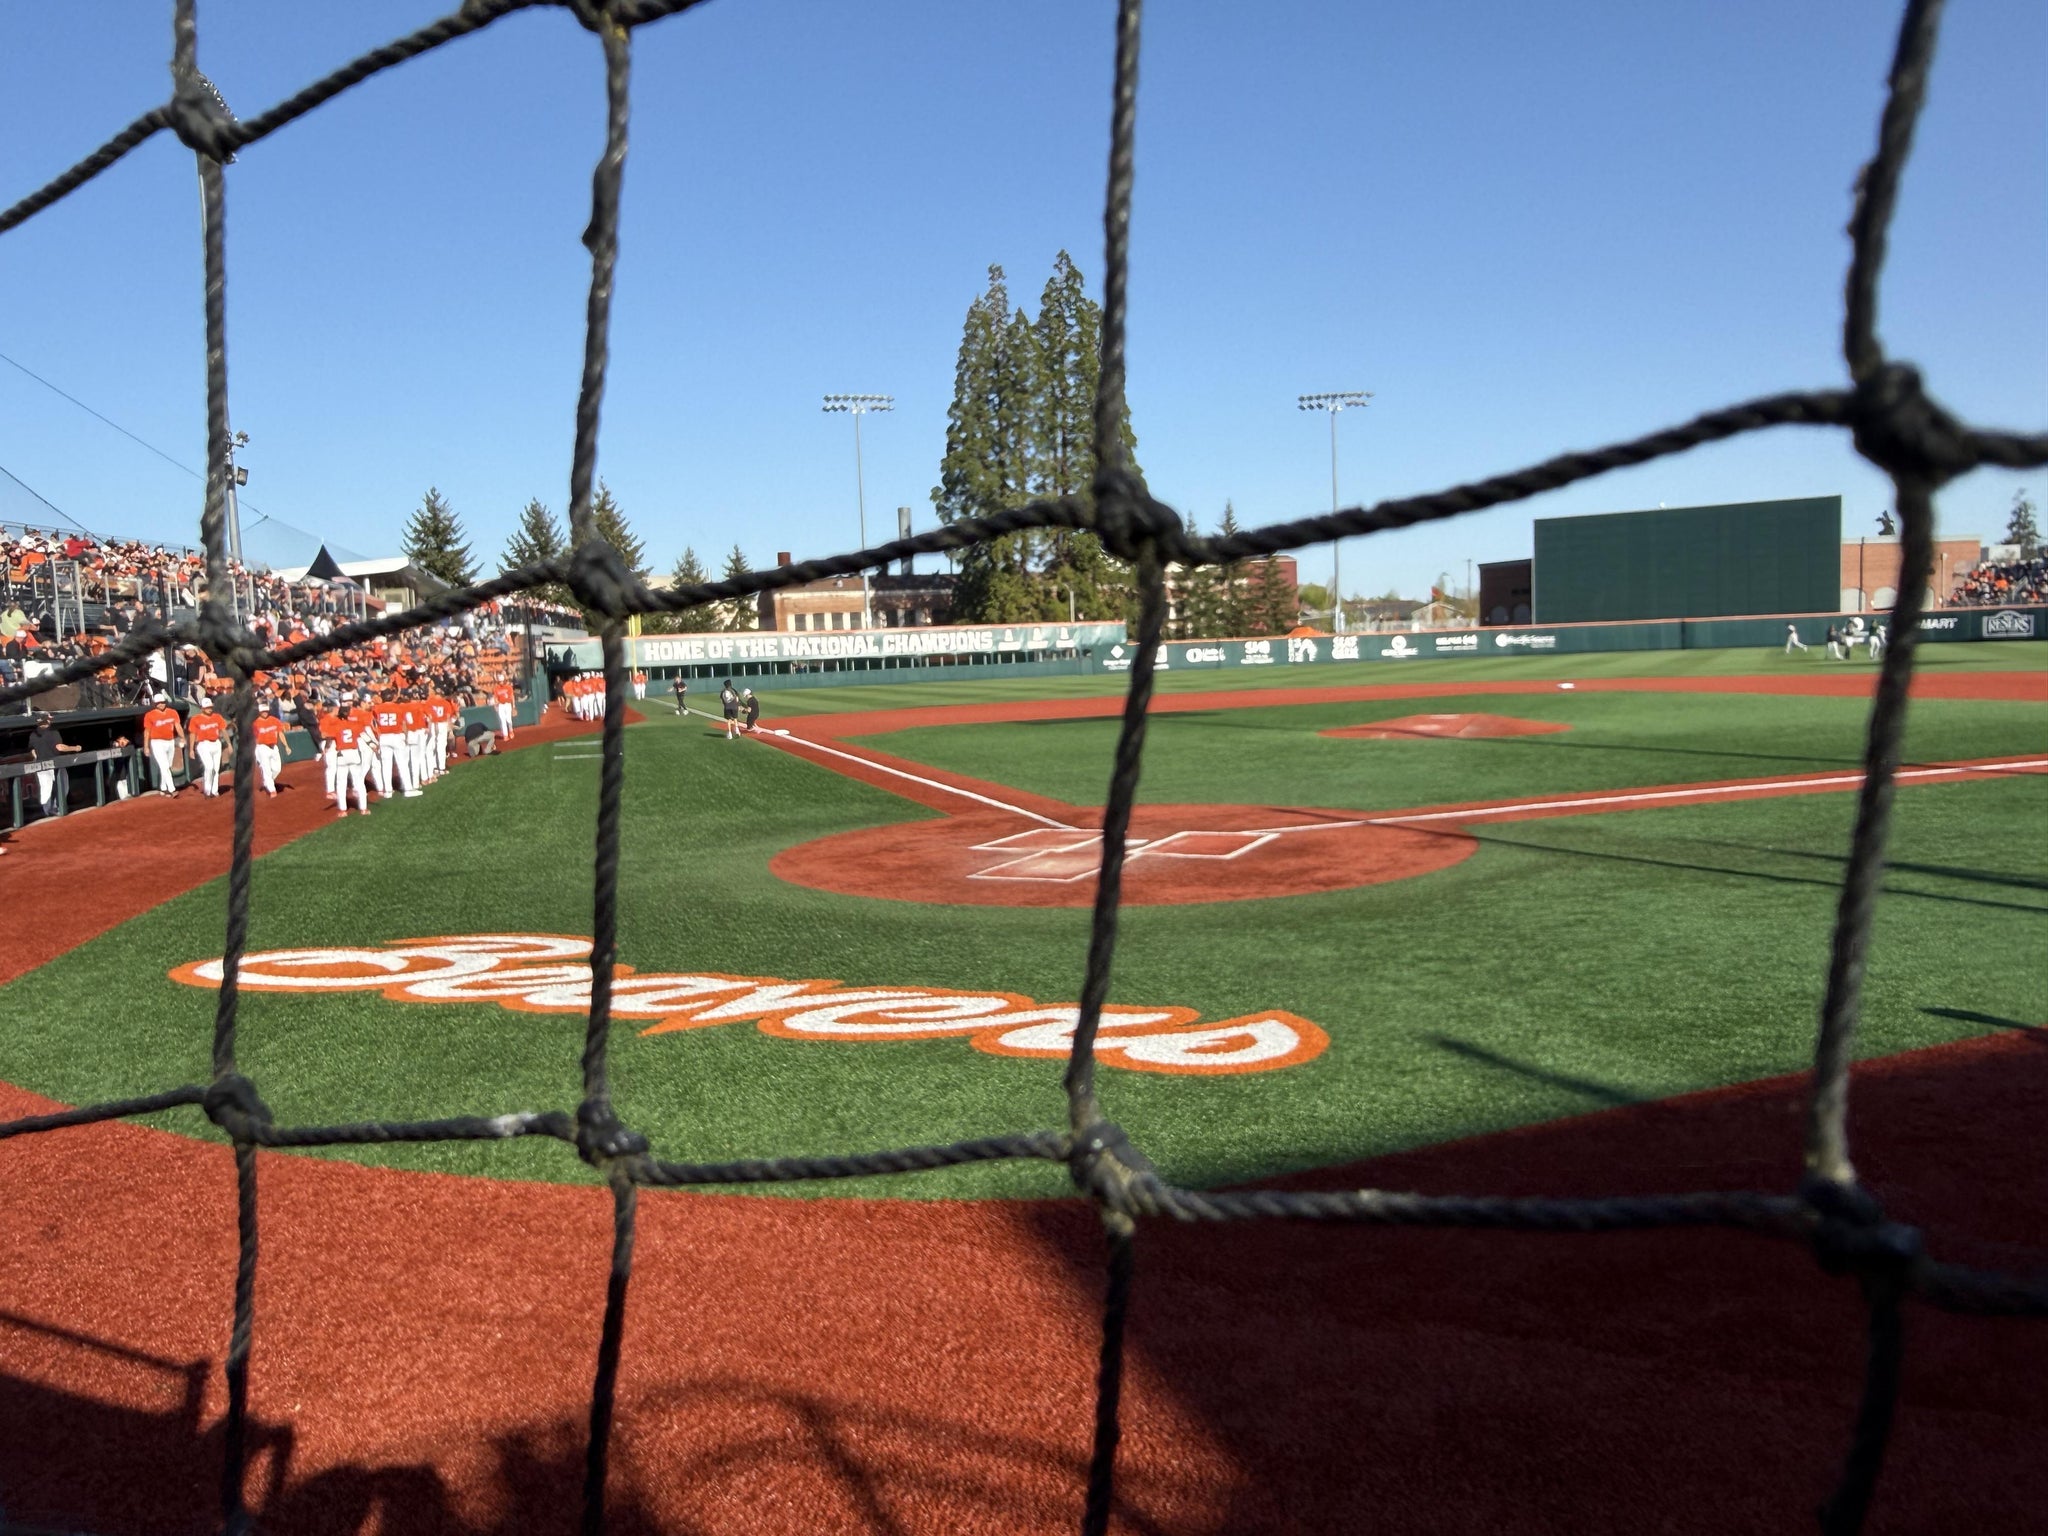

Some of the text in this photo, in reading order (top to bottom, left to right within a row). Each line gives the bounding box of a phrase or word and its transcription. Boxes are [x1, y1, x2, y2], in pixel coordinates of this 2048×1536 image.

[644, 630, 994, 661] HOME OF THE NATIONAL CHAMPIONS
[380, 712, 397, 726] 22
[342, 728, 353, 743] 2
[170, 933, 1330, 1076] Beavers
